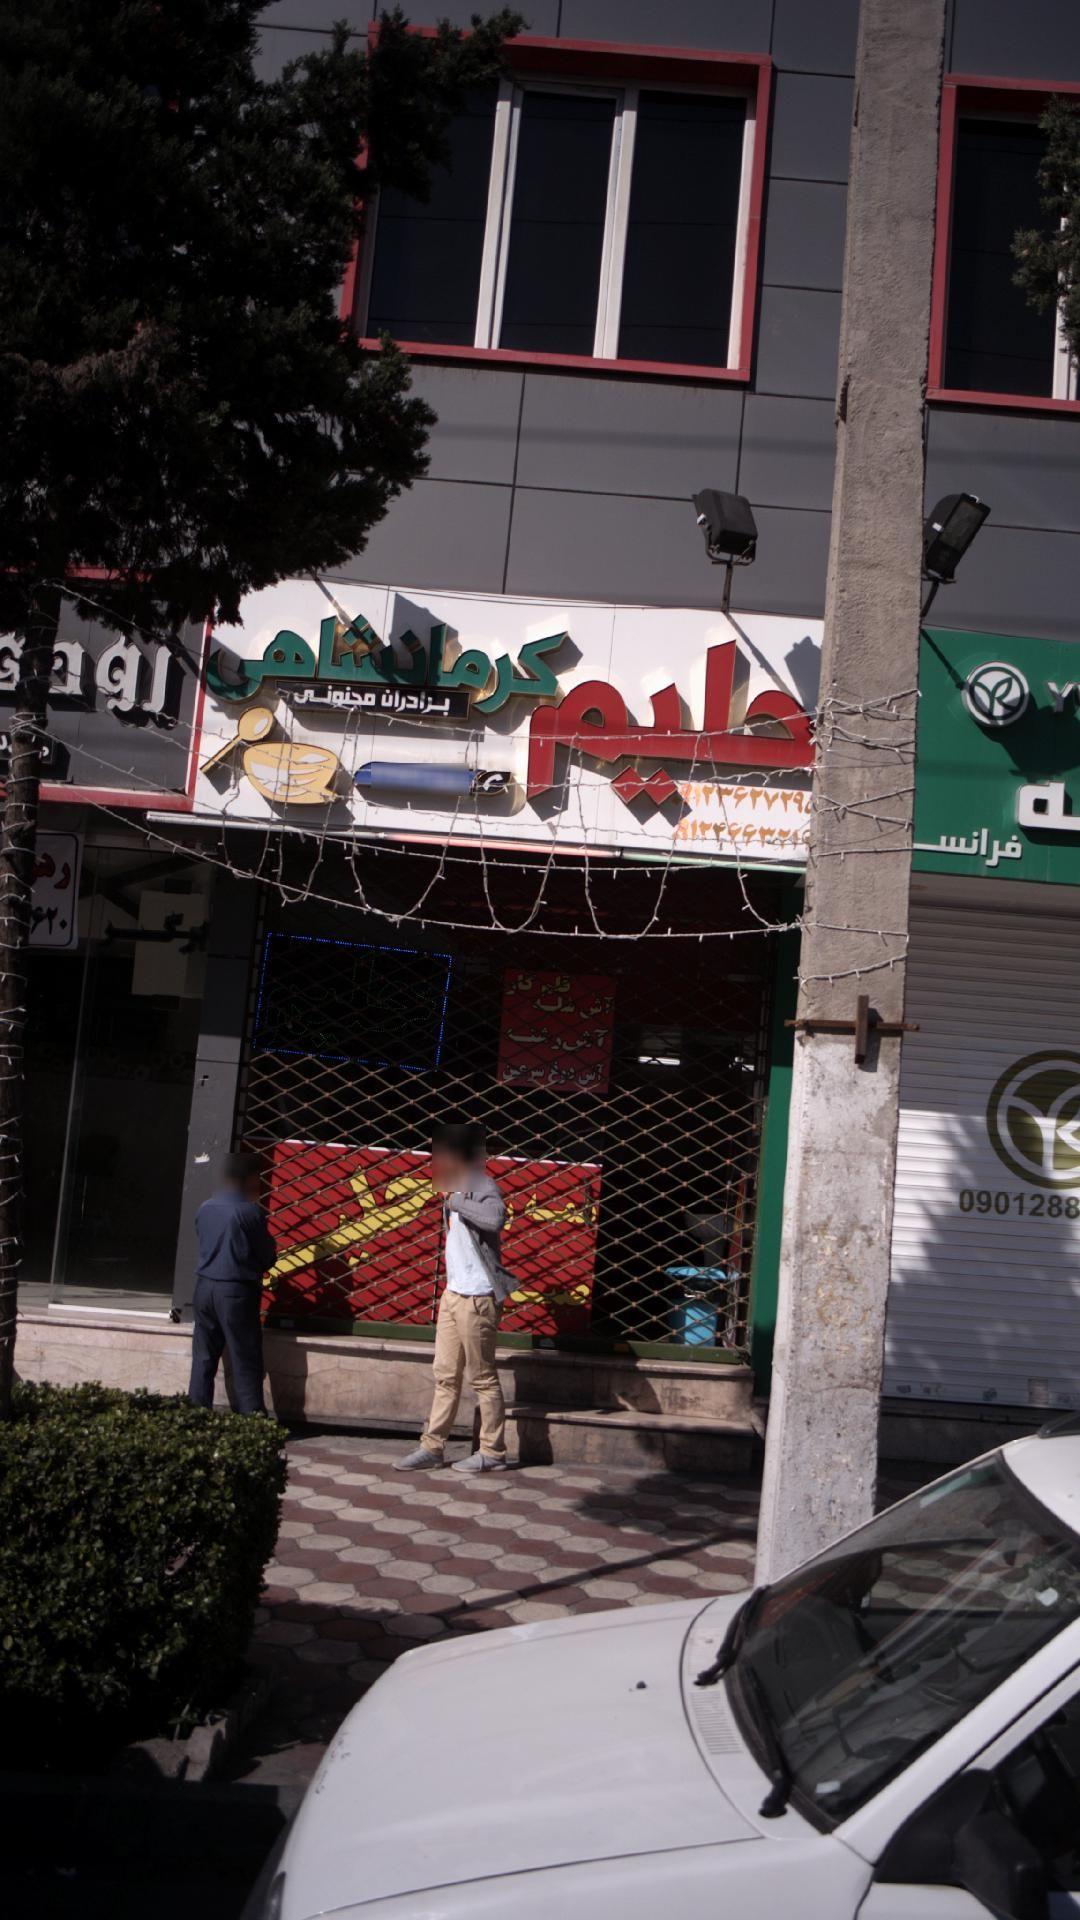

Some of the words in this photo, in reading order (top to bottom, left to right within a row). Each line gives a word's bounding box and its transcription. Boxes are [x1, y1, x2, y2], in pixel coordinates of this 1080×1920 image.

[206, 614, 568, 714] کرمانشاهی
[381, 689, 451, 716] برادران
[913, 828, 1023, 867] فرانس
